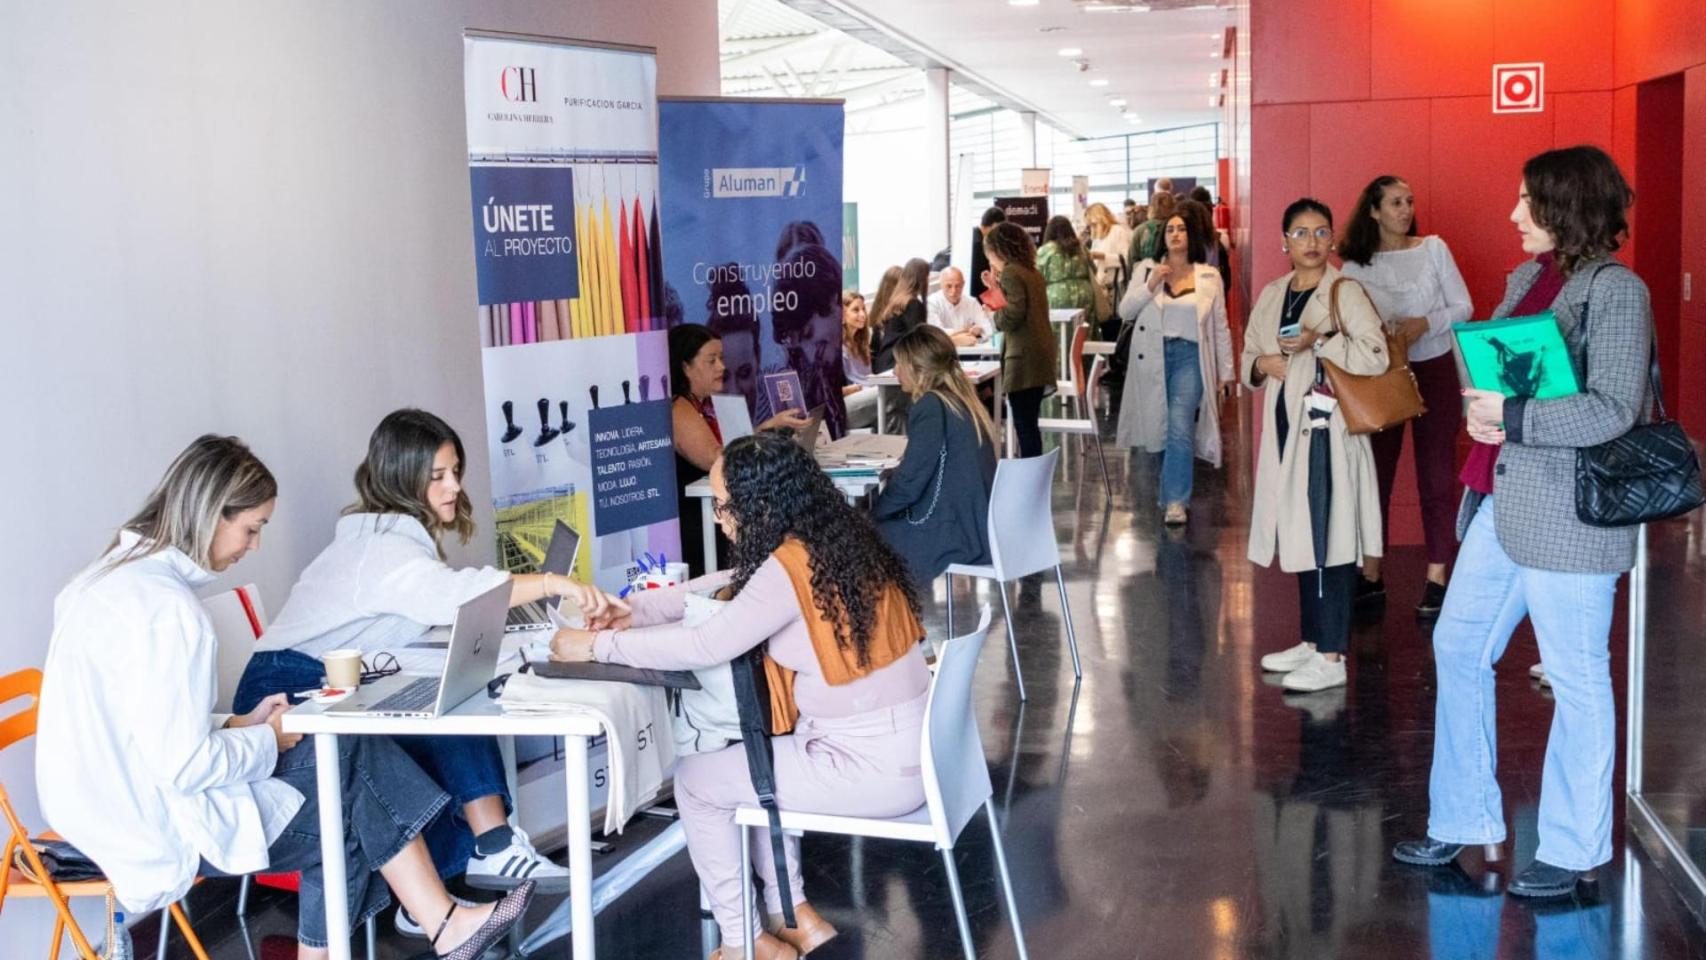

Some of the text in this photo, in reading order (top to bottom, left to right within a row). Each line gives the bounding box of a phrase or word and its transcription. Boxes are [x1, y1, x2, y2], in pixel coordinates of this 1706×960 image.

[501, 66, 537, 102] CH
[703, 168, 711, 198] Grupo
[719, 174, 775, 192] Aluman
[482, 196, 554, 233] ÚNETE
[484, 236, 572, 256] AL PROYECTO
[692, 256, 816, 287] Construyendo
[716, 286, 798, 322] empleo
